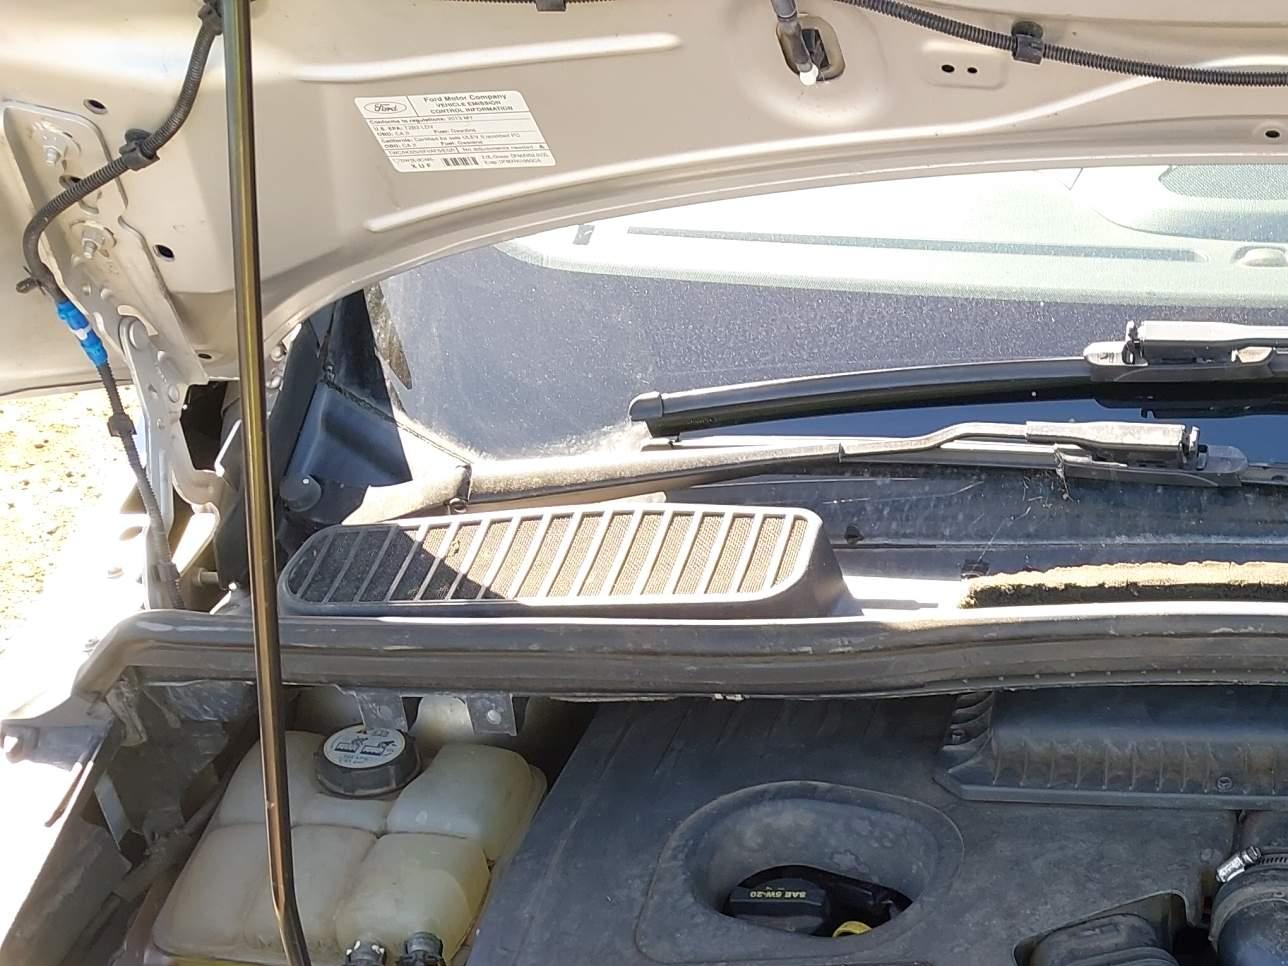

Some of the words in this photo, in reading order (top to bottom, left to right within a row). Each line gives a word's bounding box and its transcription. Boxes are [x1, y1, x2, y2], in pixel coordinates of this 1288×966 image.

[374, 103, 398, 112] Ford
[750, 890, 782, 898] 5W-20
[785, 890, 807, 898] SAE
